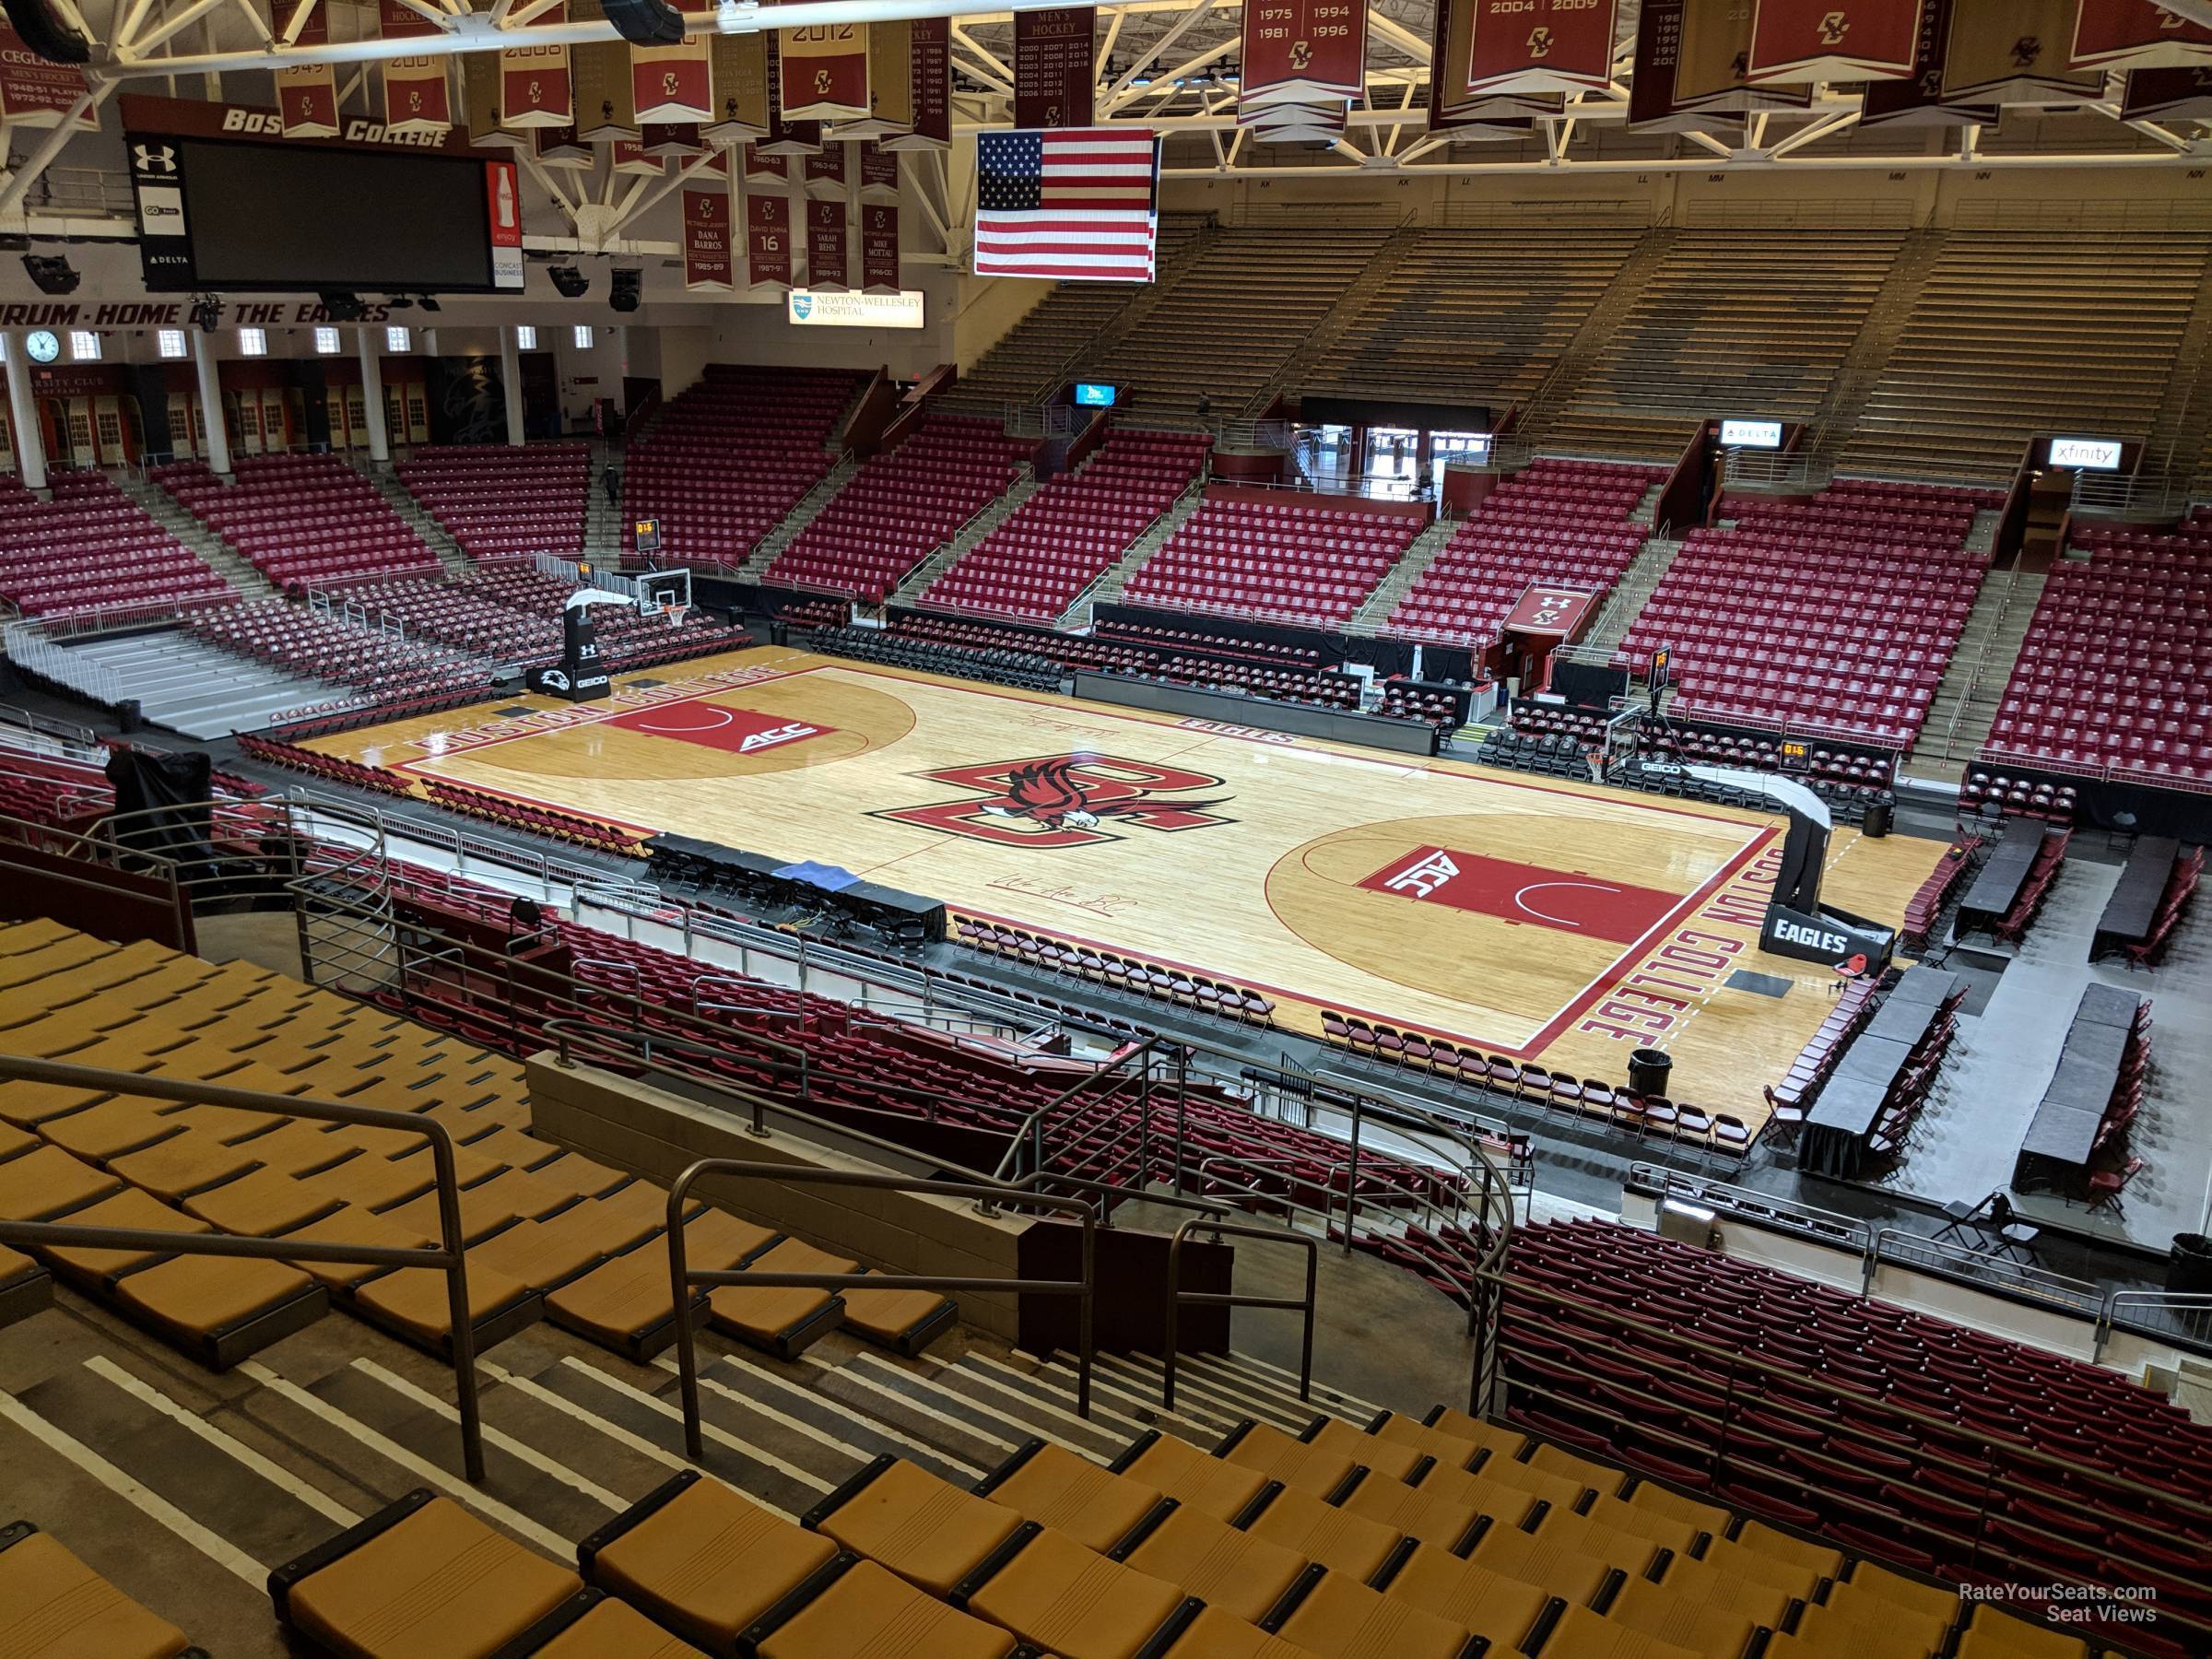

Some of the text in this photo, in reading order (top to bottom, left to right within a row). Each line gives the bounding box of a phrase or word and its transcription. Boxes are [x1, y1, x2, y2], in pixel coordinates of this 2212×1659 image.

[1490, 0, 1535, 14] 2004
[1552, 0, 1598, 10] 2009
[1259, 8, 1293, 20] 1975
[1313, 6, 1350, 18] 1994
[792, 24, 853, 42] 2012
[1032, 23, 1076, 36] HOCKEY
[1259, 28, 1289, 39] 1981
[1312, 25, 1348, 38] 1996
[222, 109, 282, 135] BOS
[698, 230, 719, 240] DANA
[817, 234, 837, 242] SARAH
[694, 240, 723, 250] BARROS
[760, 235, 779, 252] 16
[873, 240, 888, 249] MIKE
[868, 248, 893, 258] MOTTAU
[0, 304, 80, 325] RUM
[95, 304, 182, 325] HOME
[235, 304, 286, 324] THE
[818, 305, 865, 316] HOSPITAL
[1739, 429, 1777, 439] DELTA
[2057, 444, 2113, 463] xfinity
[577, 675, 608, 688] GEICO
[1175, 717, 1301, 743] EAGLES
[739, 723, 818, 751] ACC
[1641, 762, 1681, 774] GEICO
[1384, 849, 1461, 899] ACC
[1773, 918, 1849, 954] EAGLES
[1576, 928, 1747, 1048] COLLEGE
